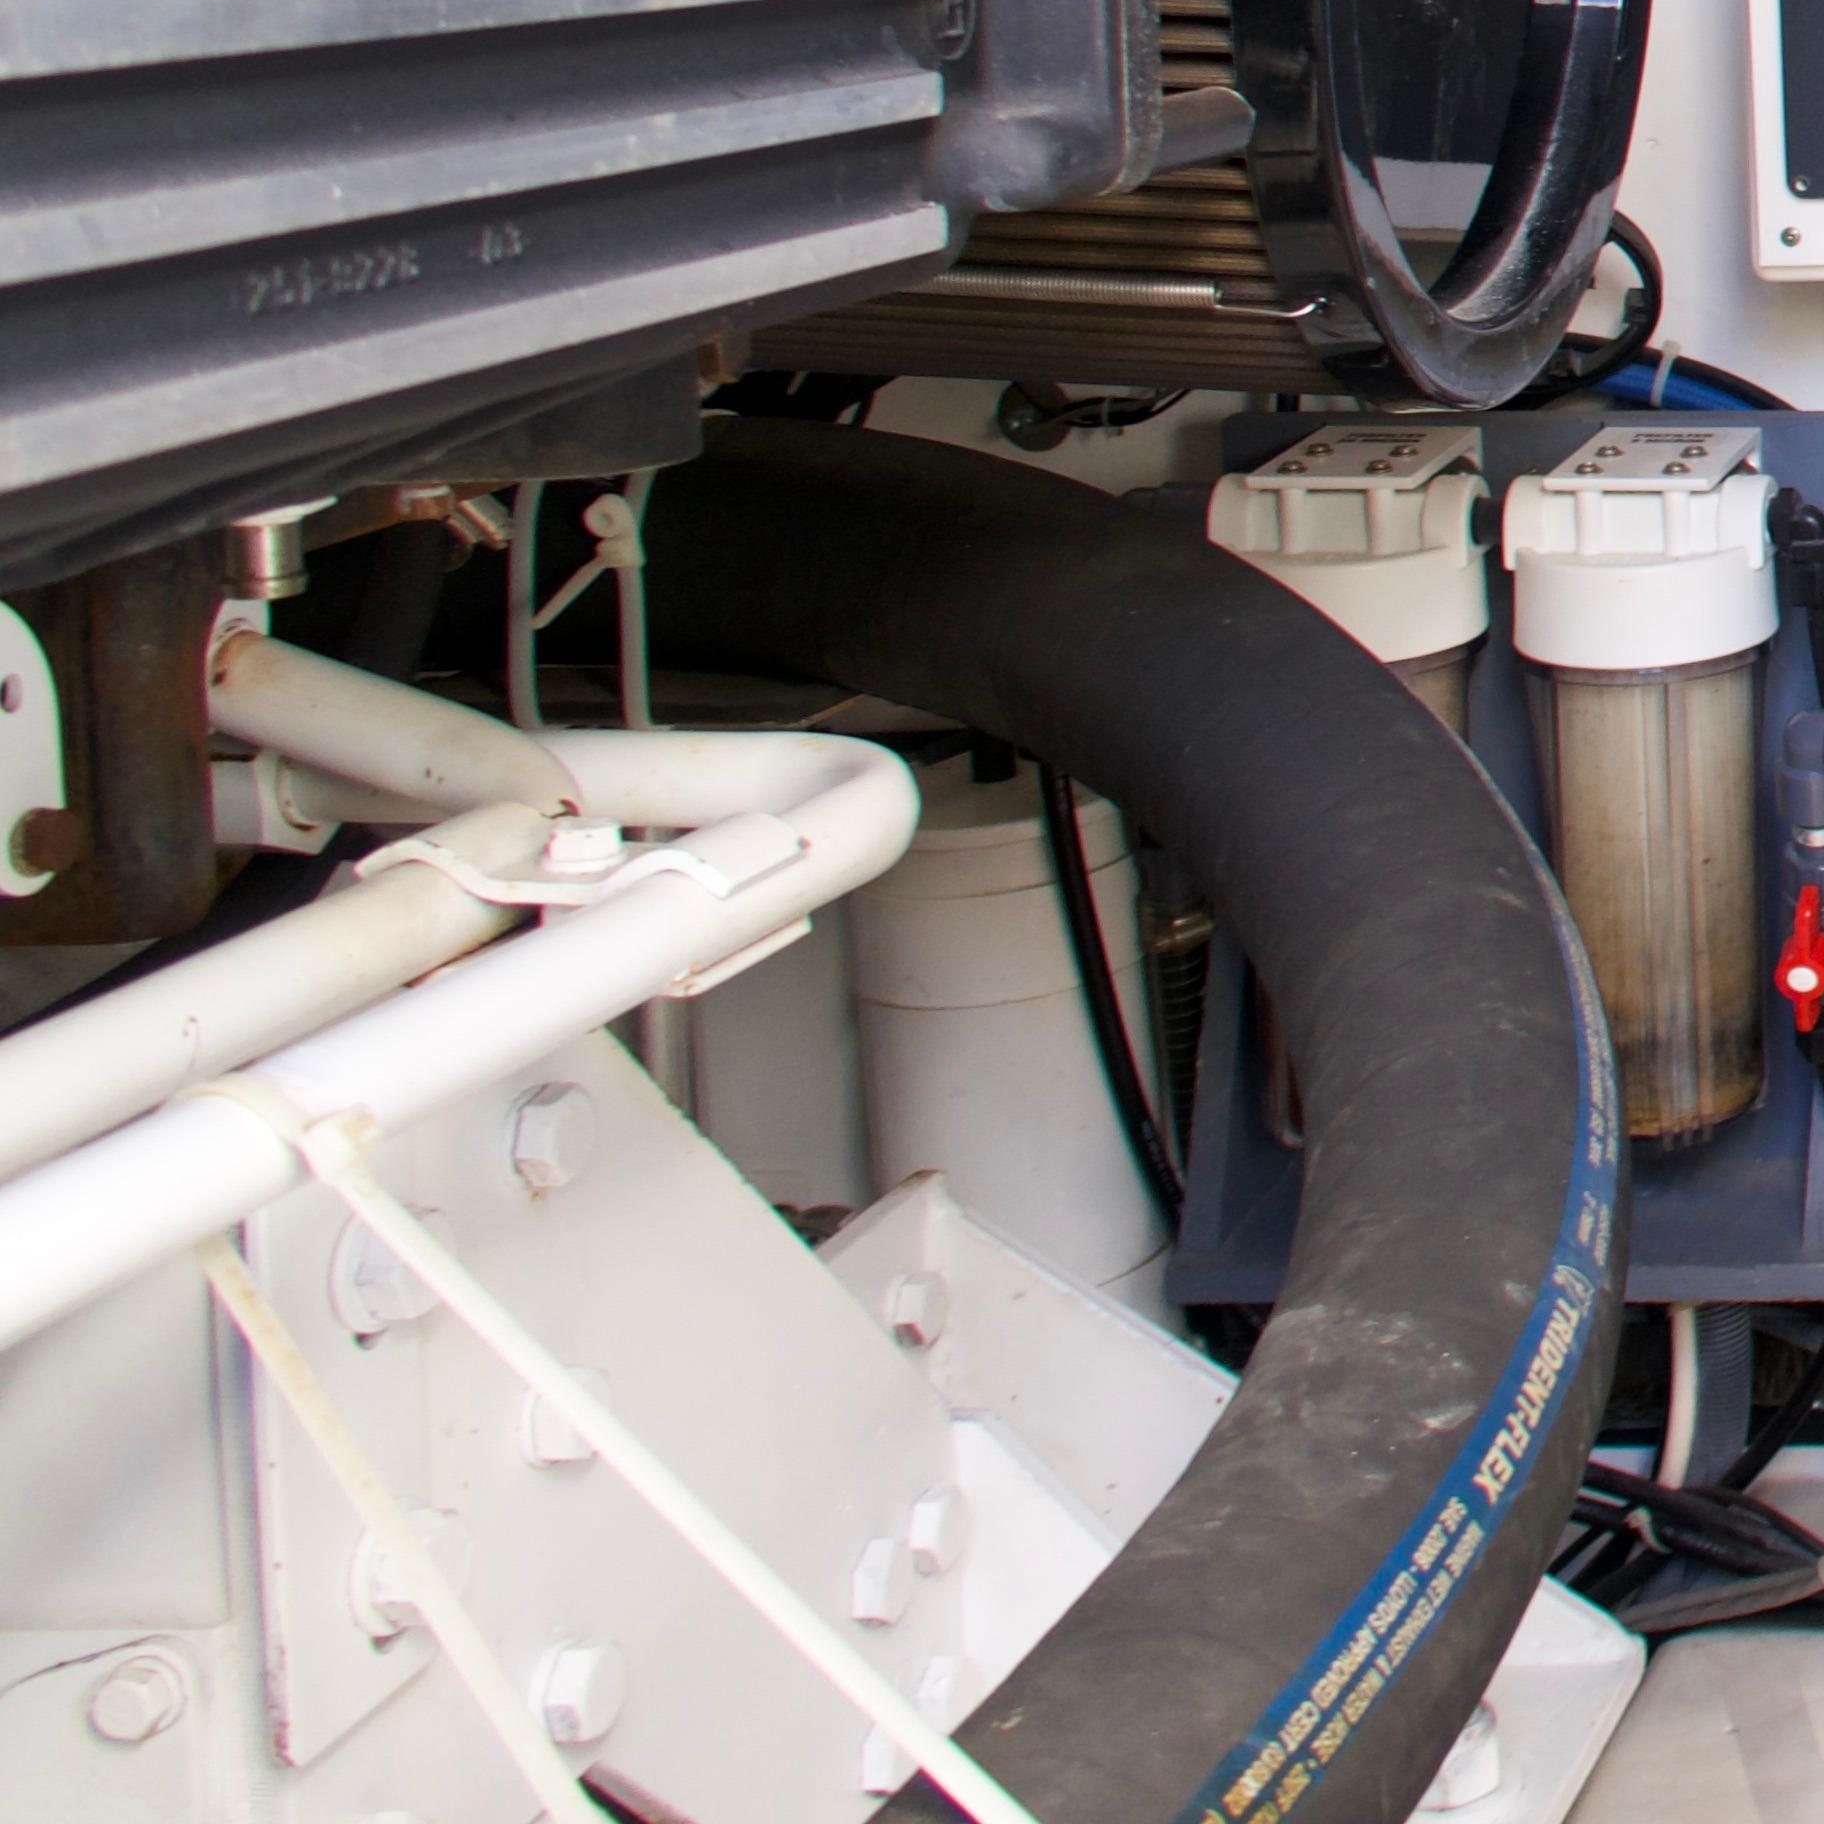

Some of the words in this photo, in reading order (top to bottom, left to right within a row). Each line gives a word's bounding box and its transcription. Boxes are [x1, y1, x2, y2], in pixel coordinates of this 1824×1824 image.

[1473, 1297, 1580, 1507] TRIDENT-FLEX
[1310, 1623, 1379, 1711] APPROVED
[1277, 1699, 1322, 1754] CERT
